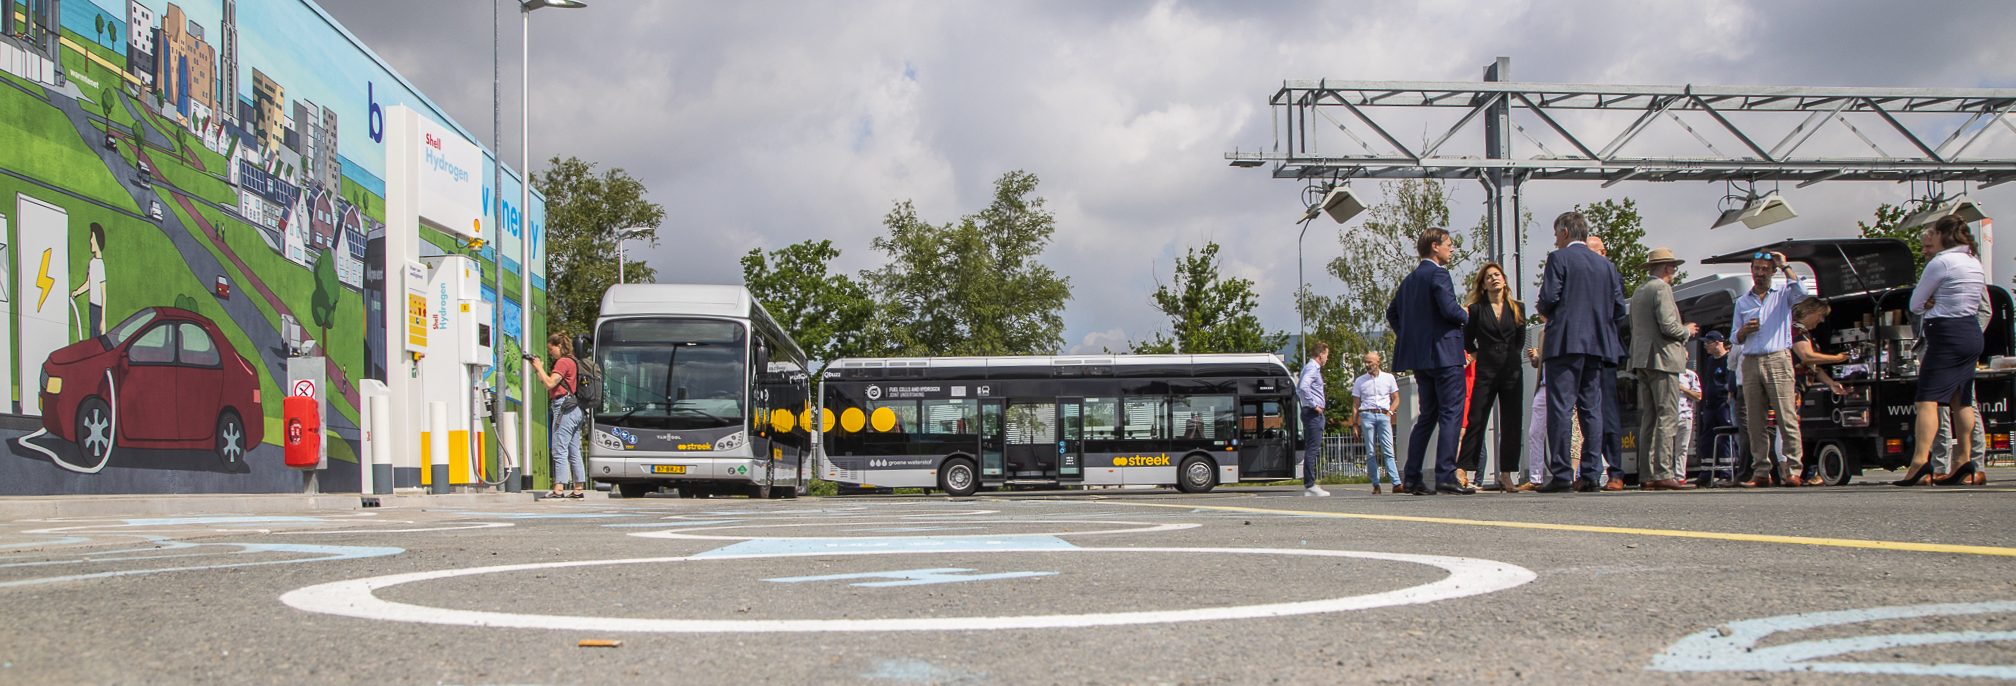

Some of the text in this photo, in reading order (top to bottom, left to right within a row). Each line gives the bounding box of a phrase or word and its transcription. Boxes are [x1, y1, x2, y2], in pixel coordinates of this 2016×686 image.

[426, 132, 441, 151] Shell
[426, 146, 469, 183] Hydrogen
[439, 282, 449, 330] Hydrogen
[823, 371, 841, 379] Qbuzz
[687, 442, 712, 450] streek
[1128, 453, 1170, 466] streek
